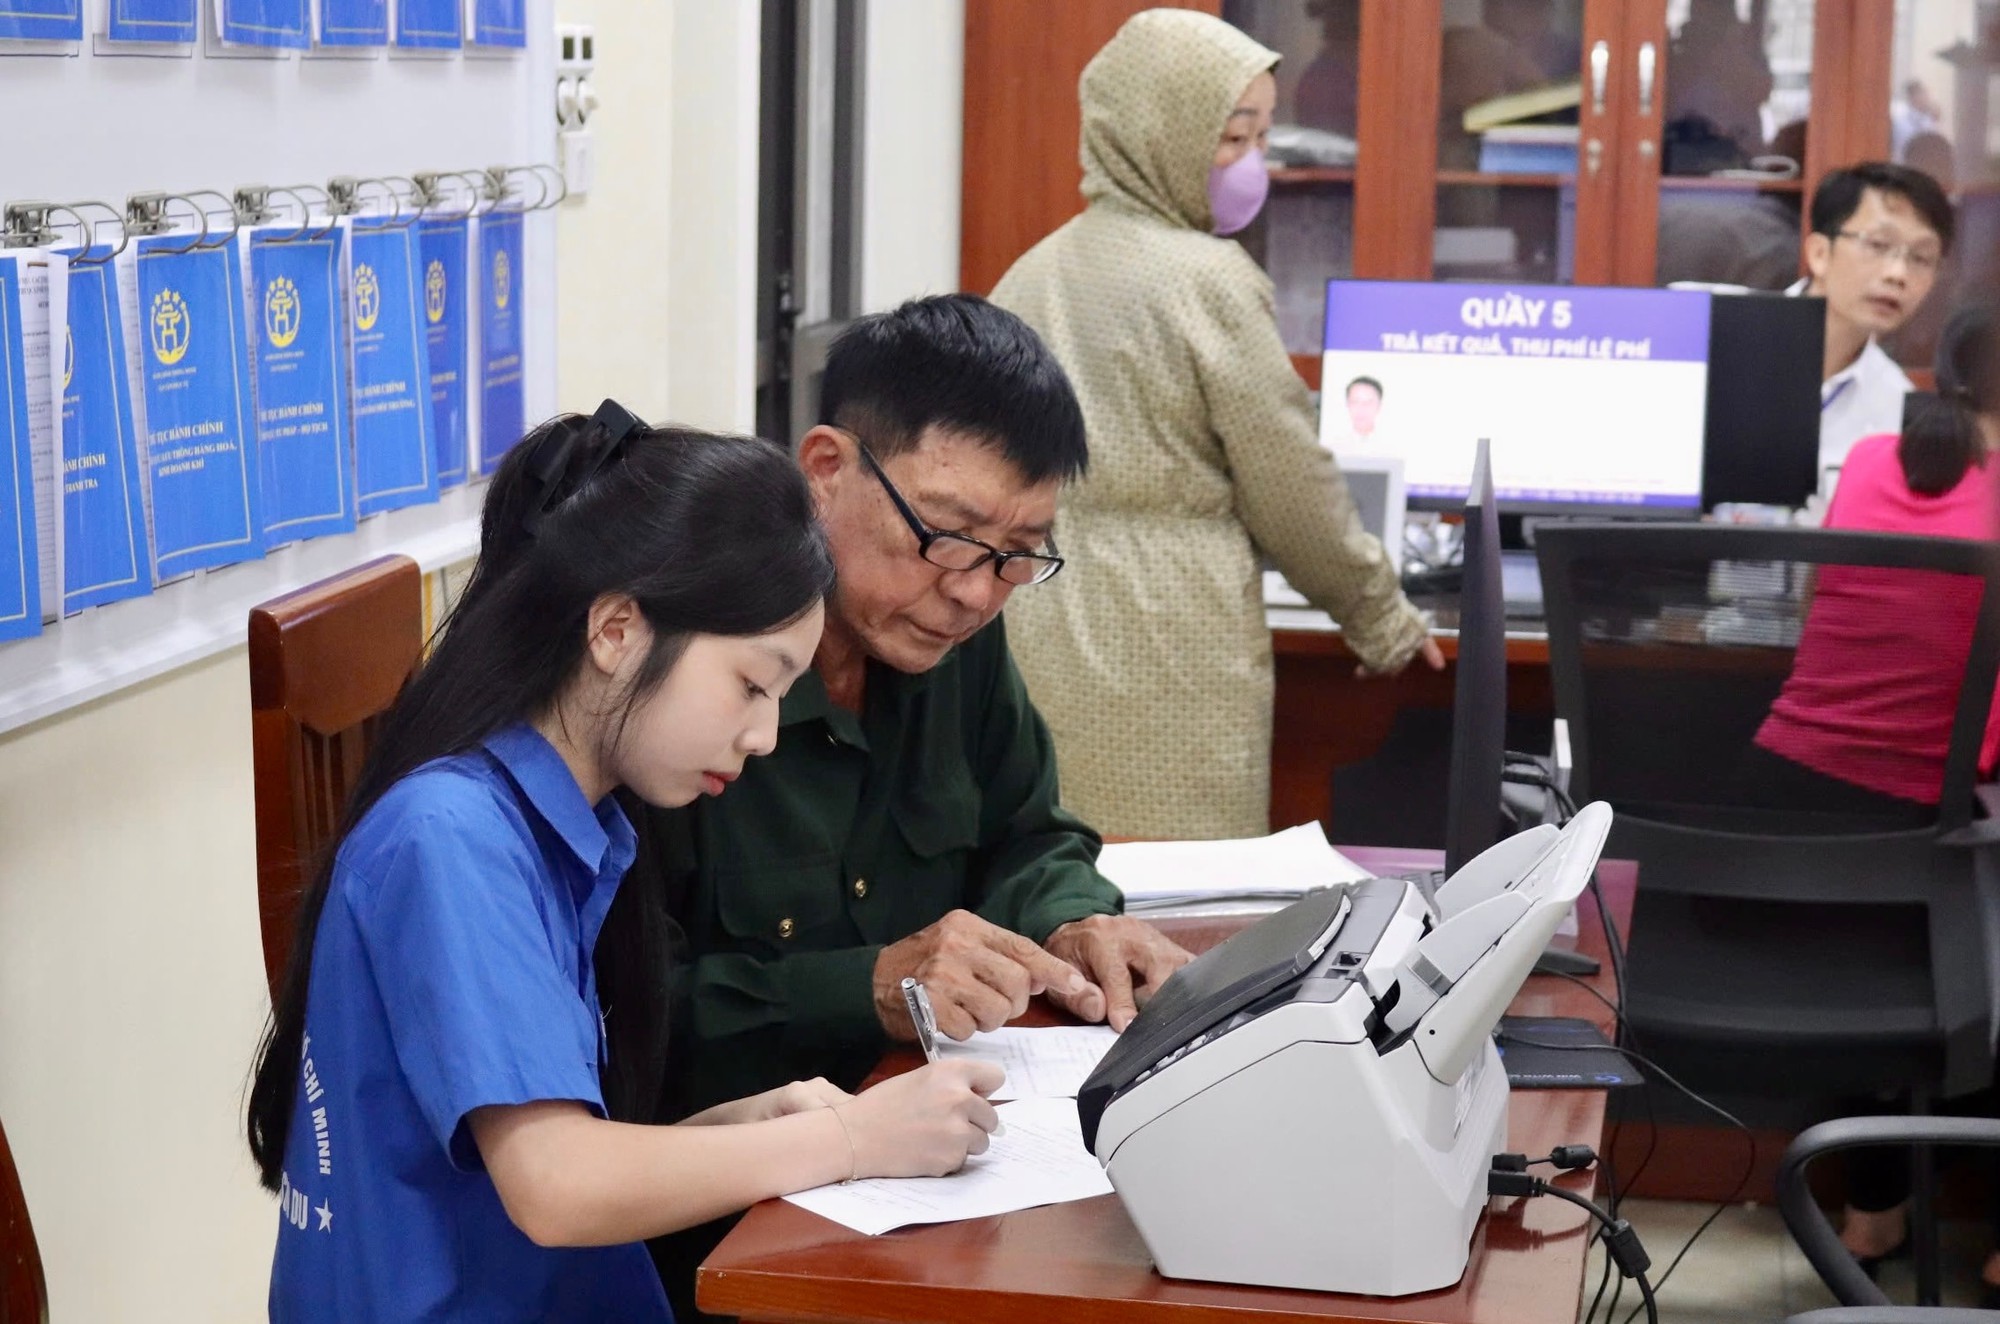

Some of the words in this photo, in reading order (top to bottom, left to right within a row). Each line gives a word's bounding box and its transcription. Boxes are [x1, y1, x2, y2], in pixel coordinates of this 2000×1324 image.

[1460, 291, 1546, 330] QUẦY
[1552, 299, 1572, 330] 5
[1381, 329, 1420, 352] TRẢ
[1422, 331, 1460, 354] KẾT
[1510, 336, 1552, 358] THU
[1553, 335, 1587, 359] PHÍ
[1615, 337, 1651, 361] PHÍ
[192, 419, 224, 437] CHÍNH
[78, 452, 106, 470] CHÍNH
[303, 1057, 325, 1104] CHÍ
[312, 1105, 332, 1176] MINH
[290, 1187, 308, 1231] DU
